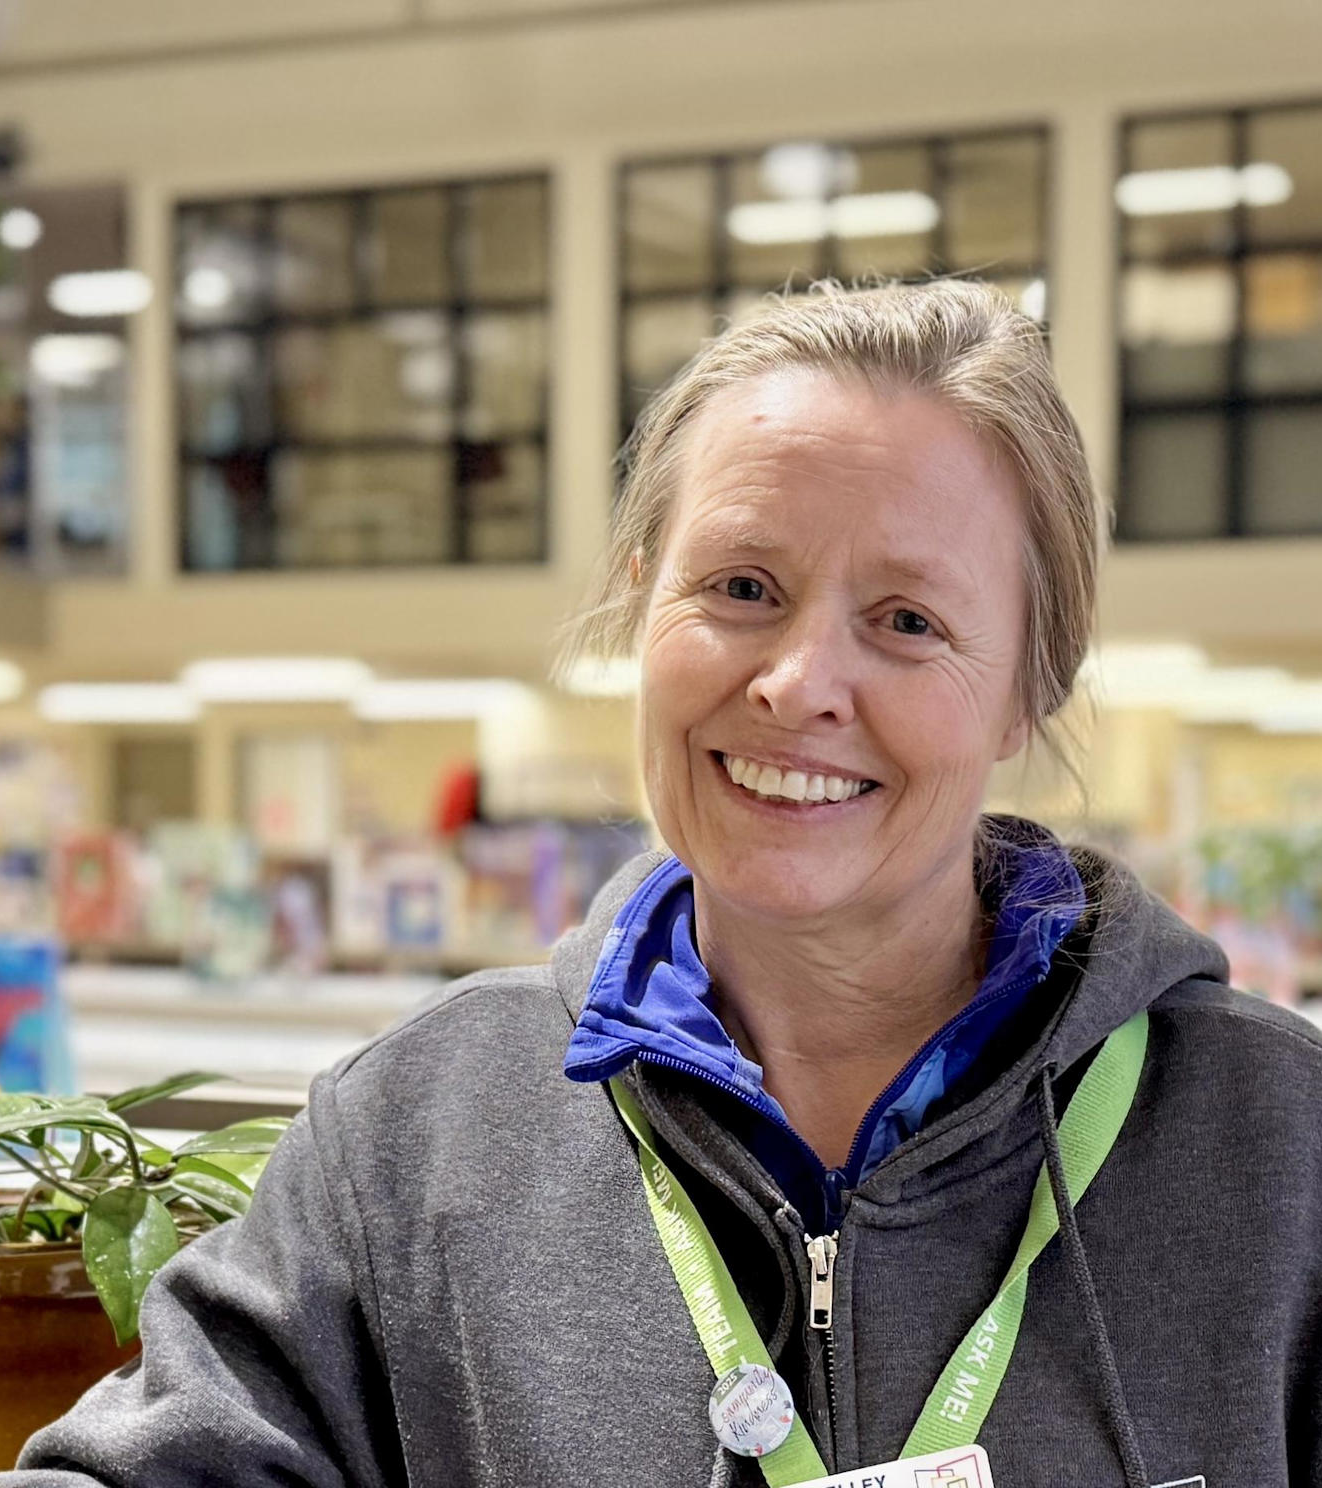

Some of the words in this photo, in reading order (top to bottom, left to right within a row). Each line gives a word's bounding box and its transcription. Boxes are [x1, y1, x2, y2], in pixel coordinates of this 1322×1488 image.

[966, 1314, 999, 1371] ASK
[717, 1372, 738, 1396] 2025
[939, 1369, 980, 1424] ME!
